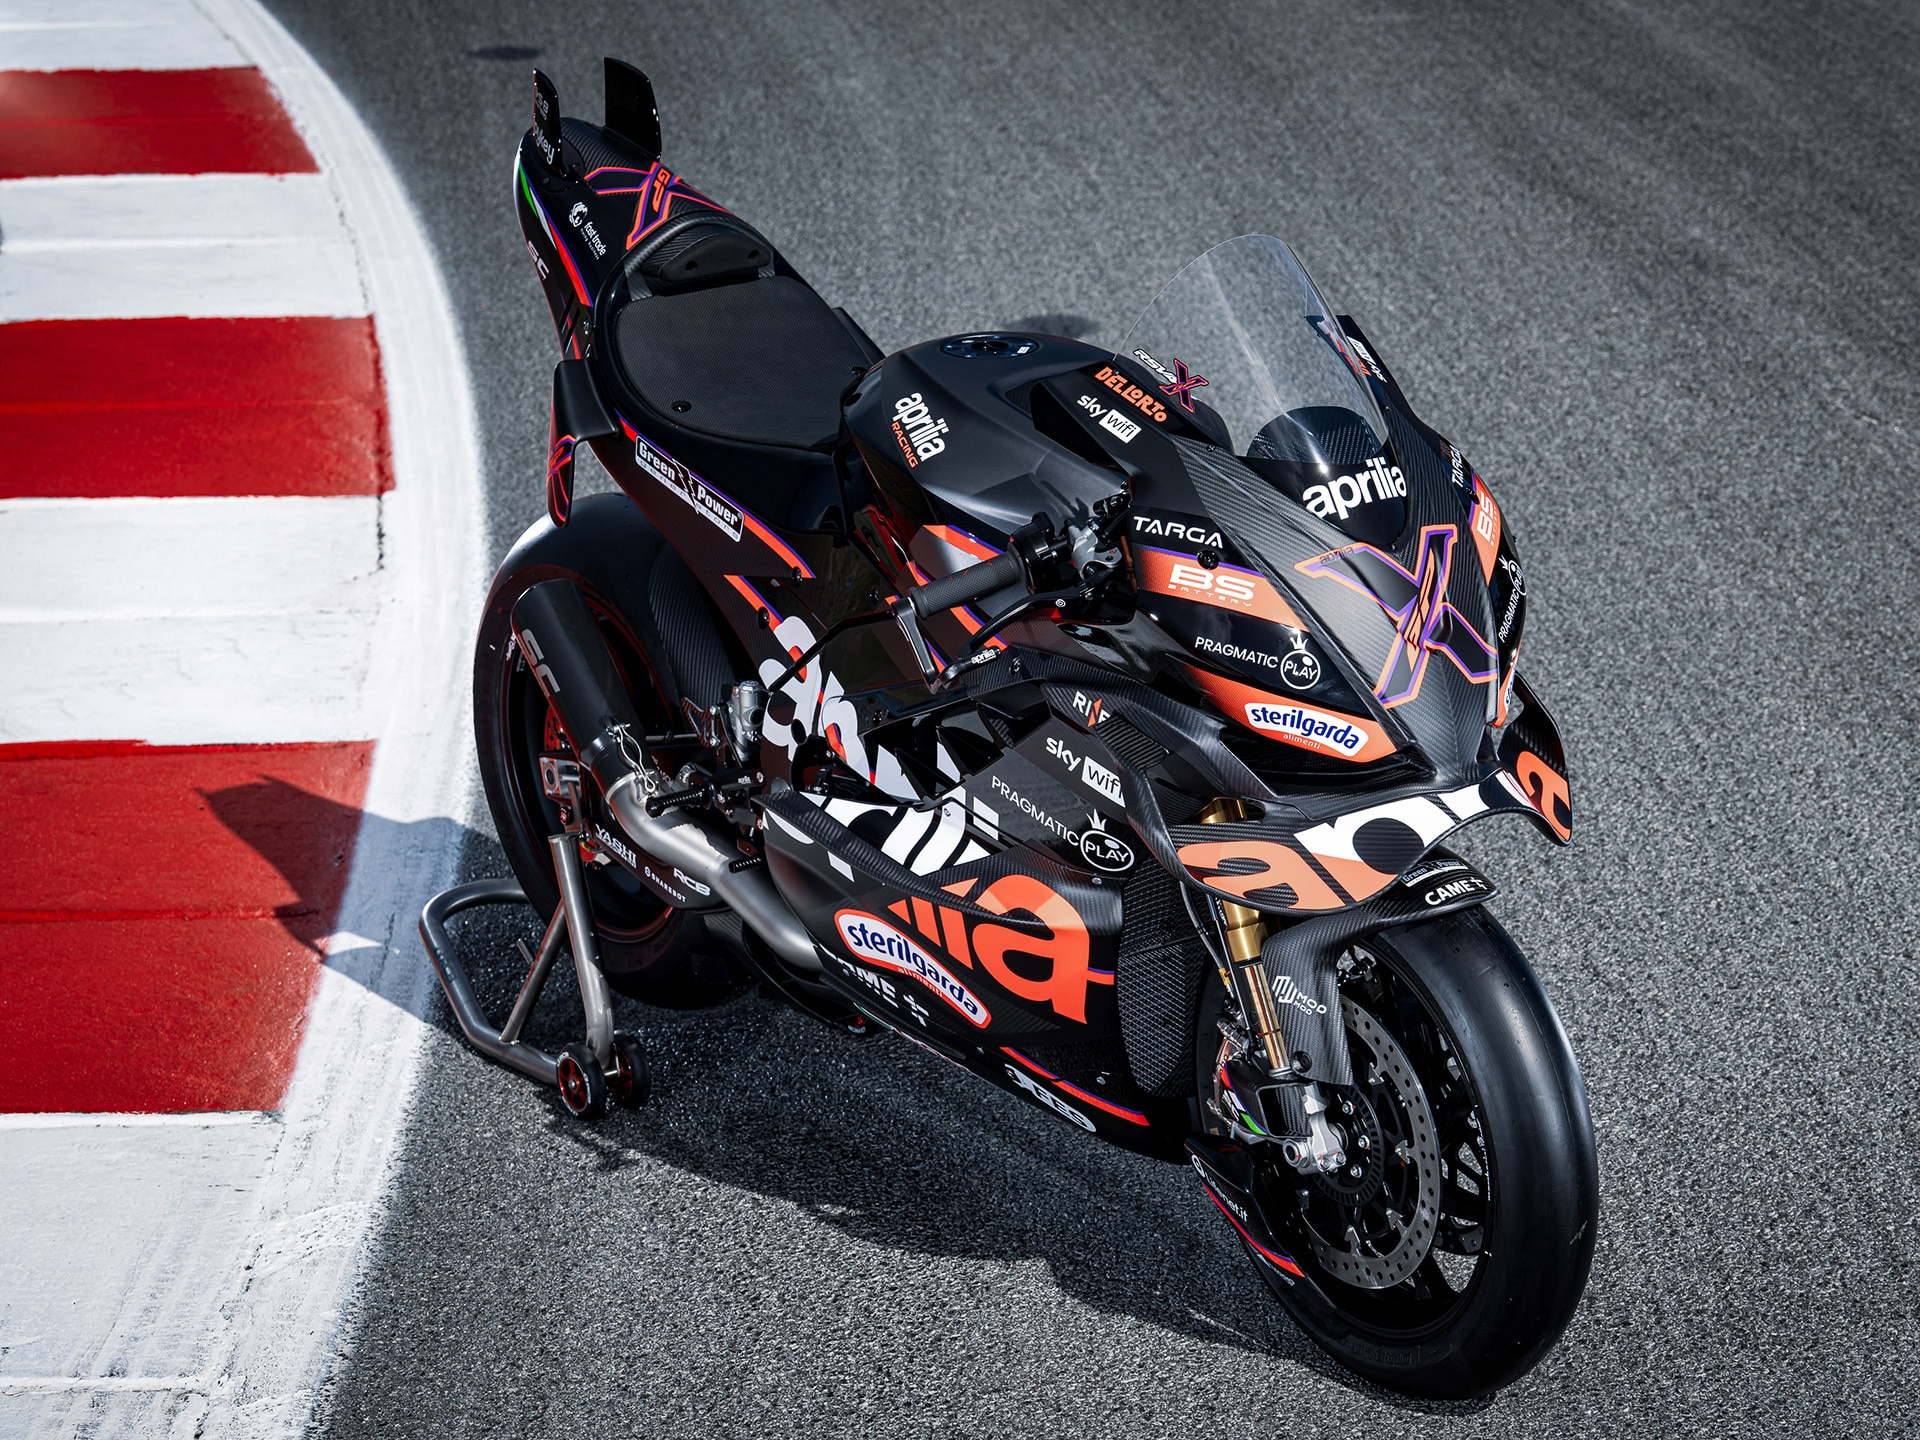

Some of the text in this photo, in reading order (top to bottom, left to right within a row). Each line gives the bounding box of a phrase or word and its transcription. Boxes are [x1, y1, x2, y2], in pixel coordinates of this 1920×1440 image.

[584, 221, 597, 239] fast
[894, 392, 949, 462] aprilia
[1077, 394, 1138, 440] sky wifi
[891, 421, 919, 468] RACING
[639, 441, 738, 526] Green Power
[1302, 457, 1407, 520] aprilia
[1133, 516, 1224, 549] TARGA
[1476, 491, 1495, 542] BS
[1319, 546, 1355, 566] aprilia
[1168, 563, 1256, 601] BS
[1498, 588, 1520, 643] PRAGMATIC
[971, 649, 996, 664] aprilia
[1194, 636, 1318, 681] PRAGMATIC PLAY
[1250, 704, 1359, 750] sterilgarda
[1283, 733, 1321, 750] alimenti
[1045, 737, 1082, 772] sky
[992, 775, 1129, 863] PRAGMATIC PLAY
[595, 823, 637, 865] YASHI
[651, 872, 687, 902] SHAREBOT
[673, 867, 711, 896] RCB
[1402, 867, 1428, 882] Green
[1424, 879, 1475, 906] CAME
[847, 922, 979, 1016] sterilgarda
[897, 965, 943, 998] alimenti
[1293, 1001, 1313, 1015] MOD
[1296, 991, 1328, 1014] MOD
